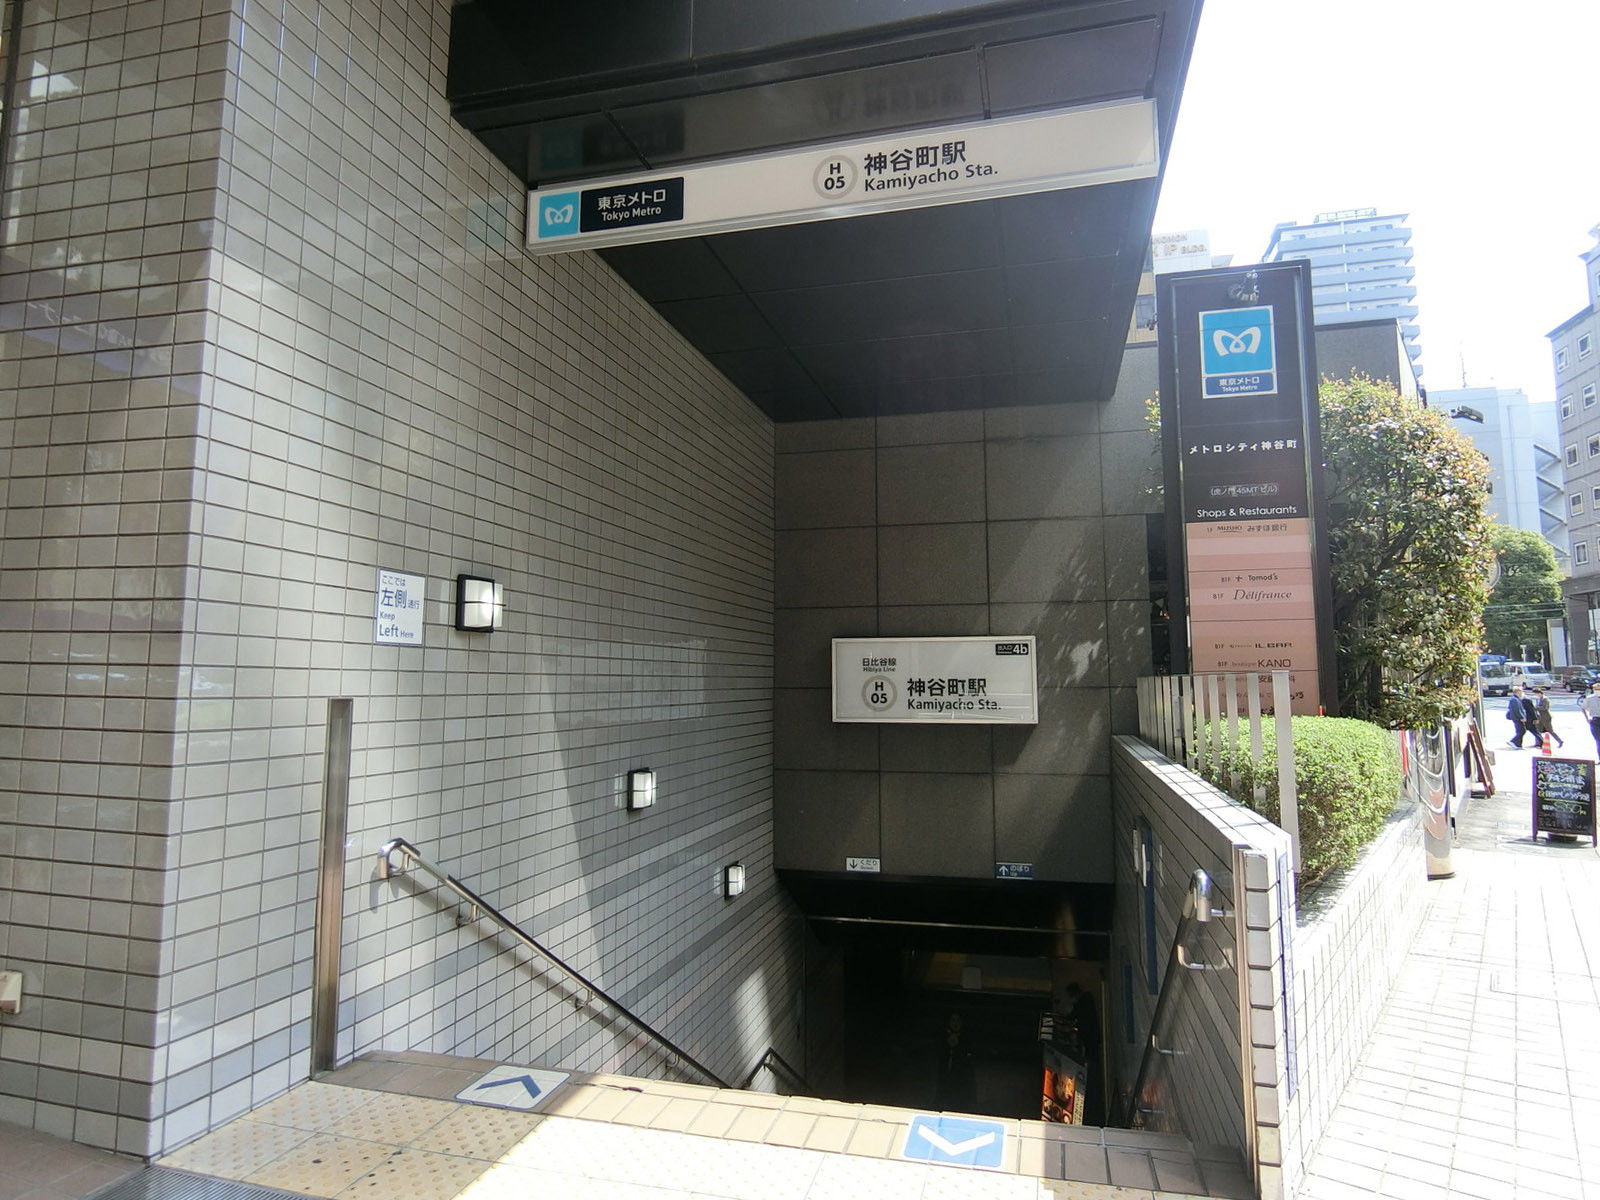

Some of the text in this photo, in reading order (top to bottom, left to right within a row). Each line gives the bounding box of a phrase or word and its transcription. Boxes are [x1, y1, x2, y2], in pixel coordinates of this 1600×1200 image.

[864, 140, 967, 176] 神谷町駅
[828, 162, 841, 175] H
[823, 174, 847, 190] 05
[864, 162, 999, 193] Kamiyacho Sta.
[597, 187, 667, 211] 東京メトロ
[601, 203, 662, 222] Tokyo Metro
[1219, 376, 1260, 387] 東京メトロ
[1189, 439, 1297, 455] メトロシティ神谷町
[1197, 505, 1297, 519] Shops & Restaurants
[382, 575, 406, 587] ここでは
[1248, 573, 1278, 582] Tomod's
[1233, 588, 1292, 602] Délifrance
[380, 612, 396, 621] Keep
[379, 624, 415, 639] Left Here
[1013, 644, 1028, 655] 4b
[862, 657, 897, 667] 日比谷線
[1257, 659, 1291, 668] KANO
[874, 682, 884, 691] H
[907, 678, 987, 697] 神谷町駅
[870, 692, 888, 704] 05
[907, 698, 1002, 713] Kamiyacho Sta.
